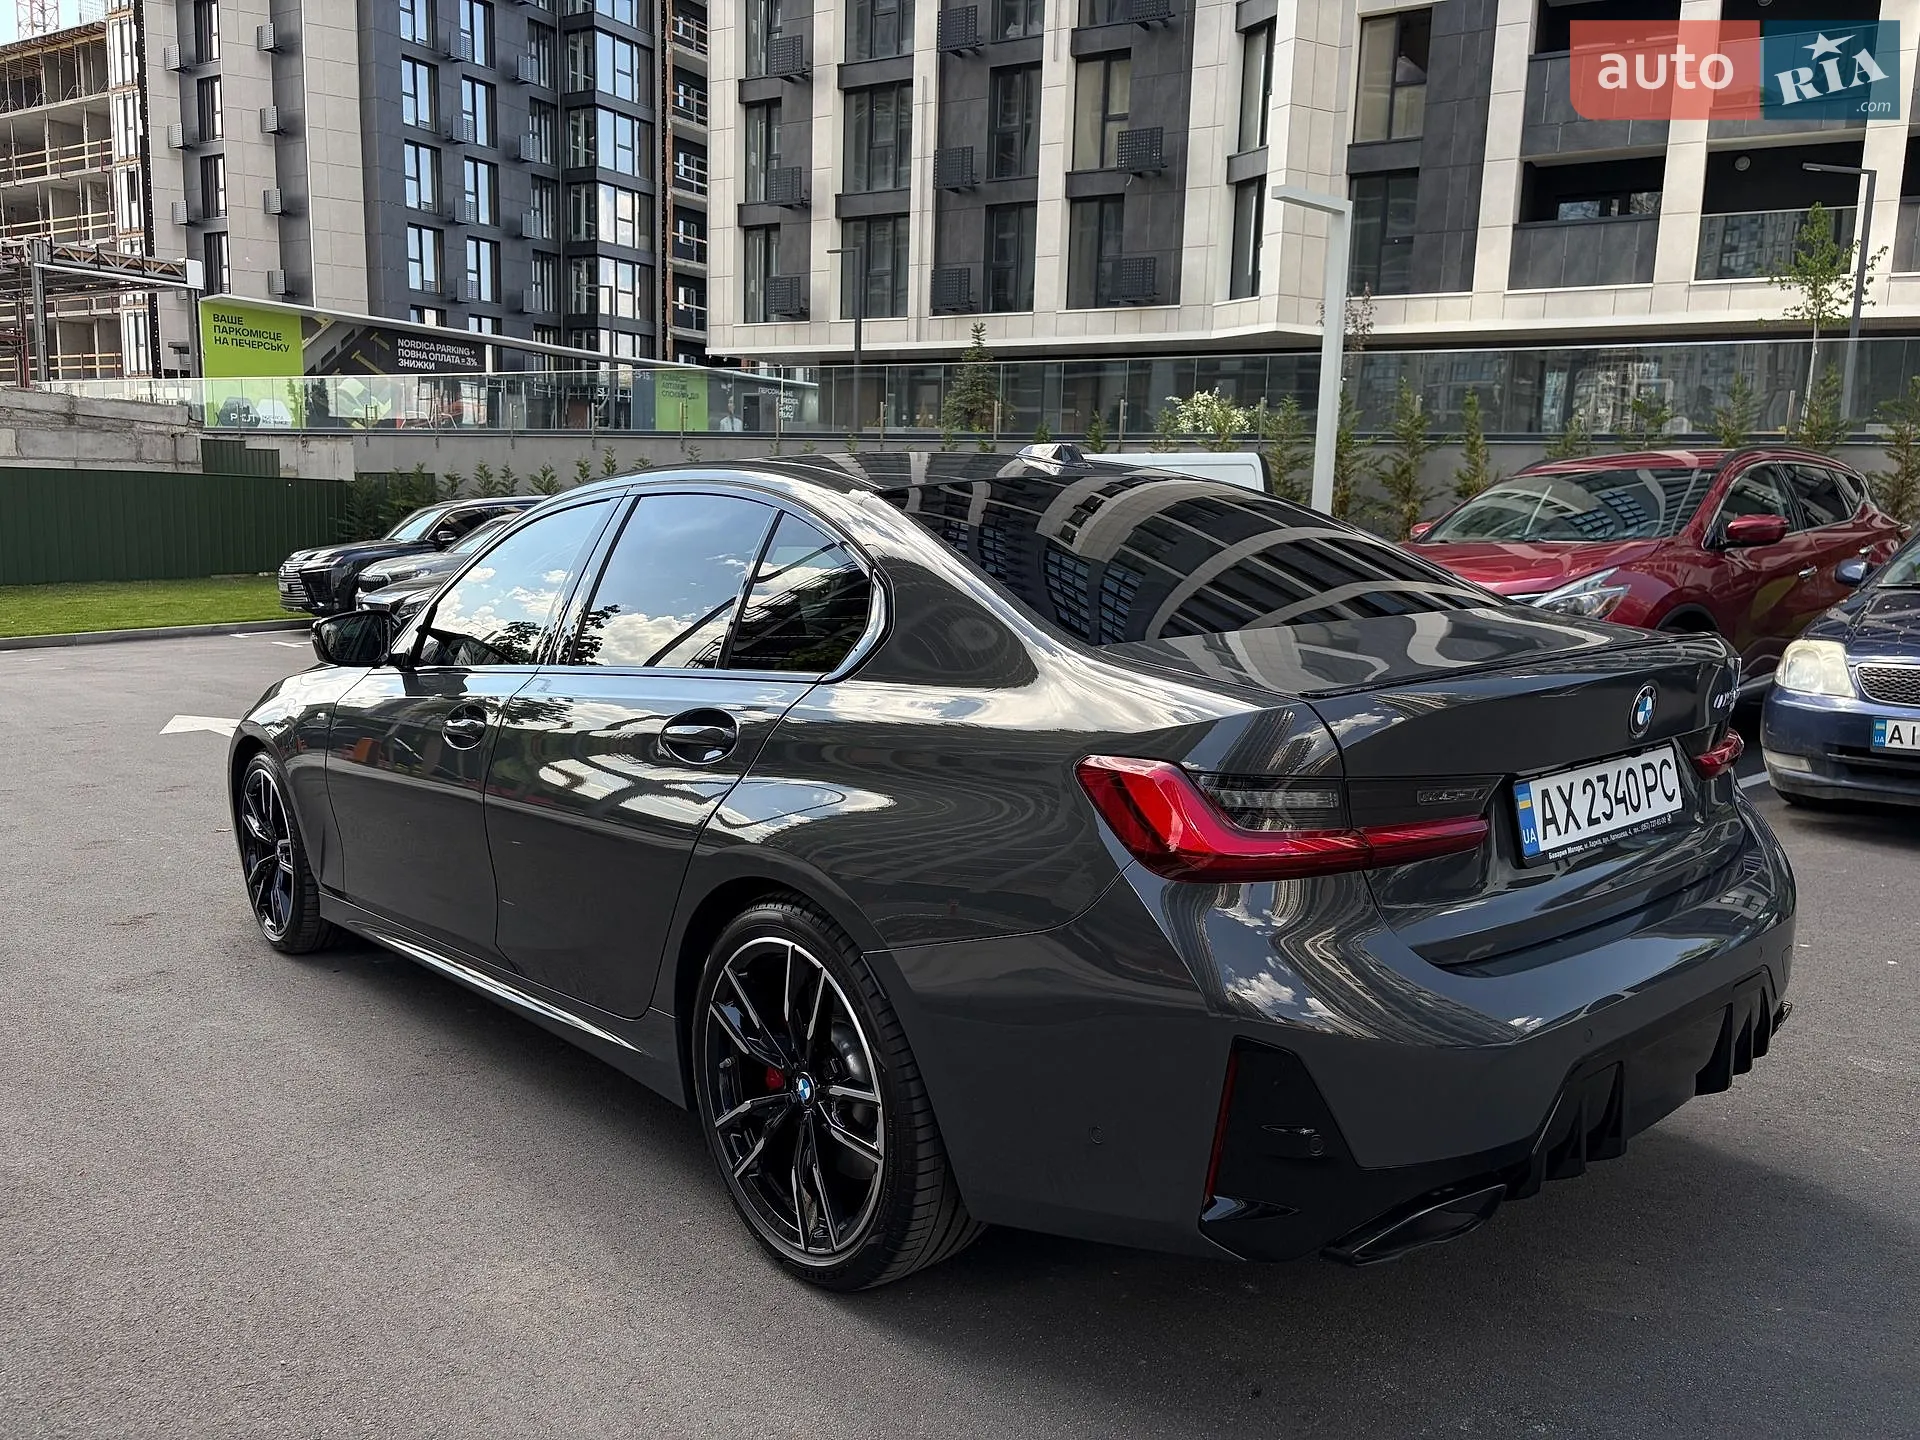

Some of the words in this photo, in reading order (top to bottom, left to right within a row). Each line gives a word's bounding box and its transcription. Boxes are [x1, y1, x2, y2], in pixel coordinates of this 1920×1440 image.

[213, 313, 244, 326] ВАШЕ
[213, 325, 282, 342] ПАРКОМІСЦЕ
[214, 336, 229, 346] НА
[231, 338, 290, 352] ПЕЧЕРСЬКУ
[397, 338, 435, 352] NORDICA
[436, 343, 470, 356] PARKING
[398, 348, 428, 360] ПОВНА
[428, 352, 460, 364] ОПЛАТА
[466, 357, 478, 366] 3%
[398, 358, 435, 370] ЗНИЖКИ
[1874, 735, 1885, 744] UA
[1888, 724, 1916, 746] AI
[1523, 829, 1537, 844] UA
[1541, 782, 1582, 841] AX
[1582, 766, 1640, 828] 2340
[1640, 758, 1676, 809] PC
